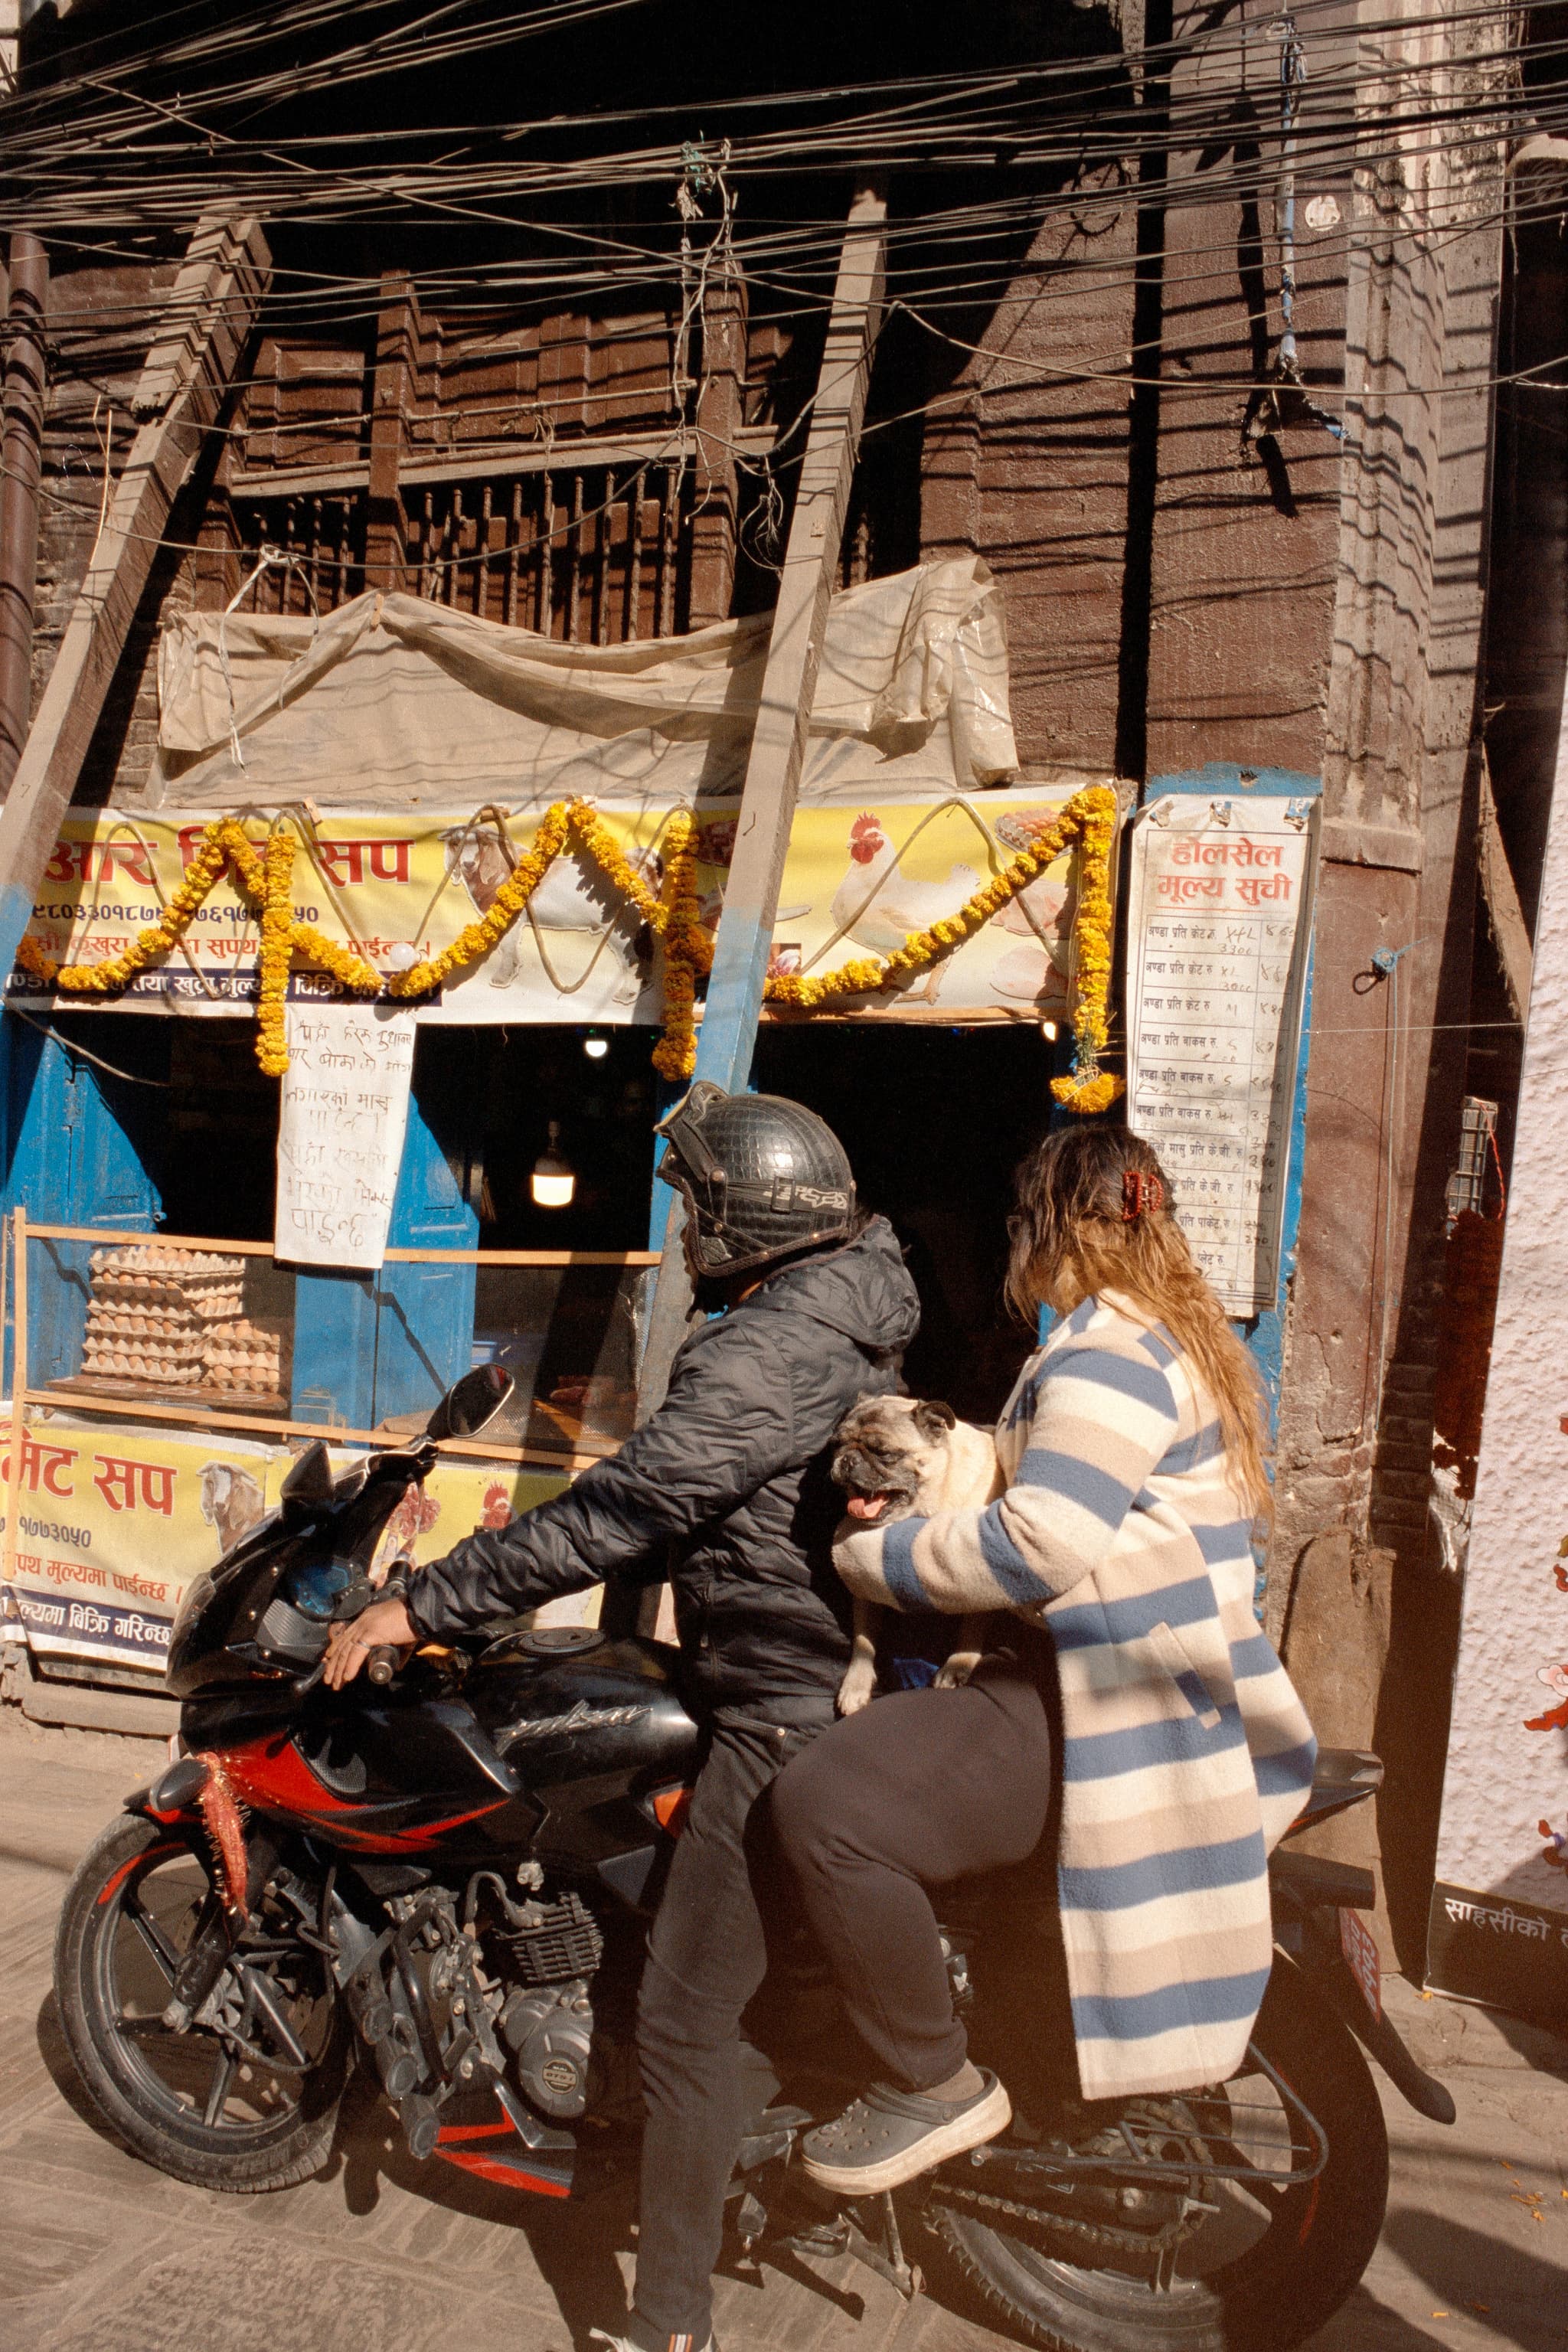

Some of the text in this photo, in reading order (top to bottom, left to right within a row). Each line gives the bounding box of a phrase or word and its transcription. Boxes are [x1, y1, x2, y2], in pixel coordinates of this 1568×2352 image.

[310, 839, 415, 887] सप
[1171, 837, 1285, 867] होलसेल
[93, 1455, 178, 1516] सप
[47, 1559, 107, 1588] मुल्यमा
[112, 1573, 170, 1602] पाईन्छ
